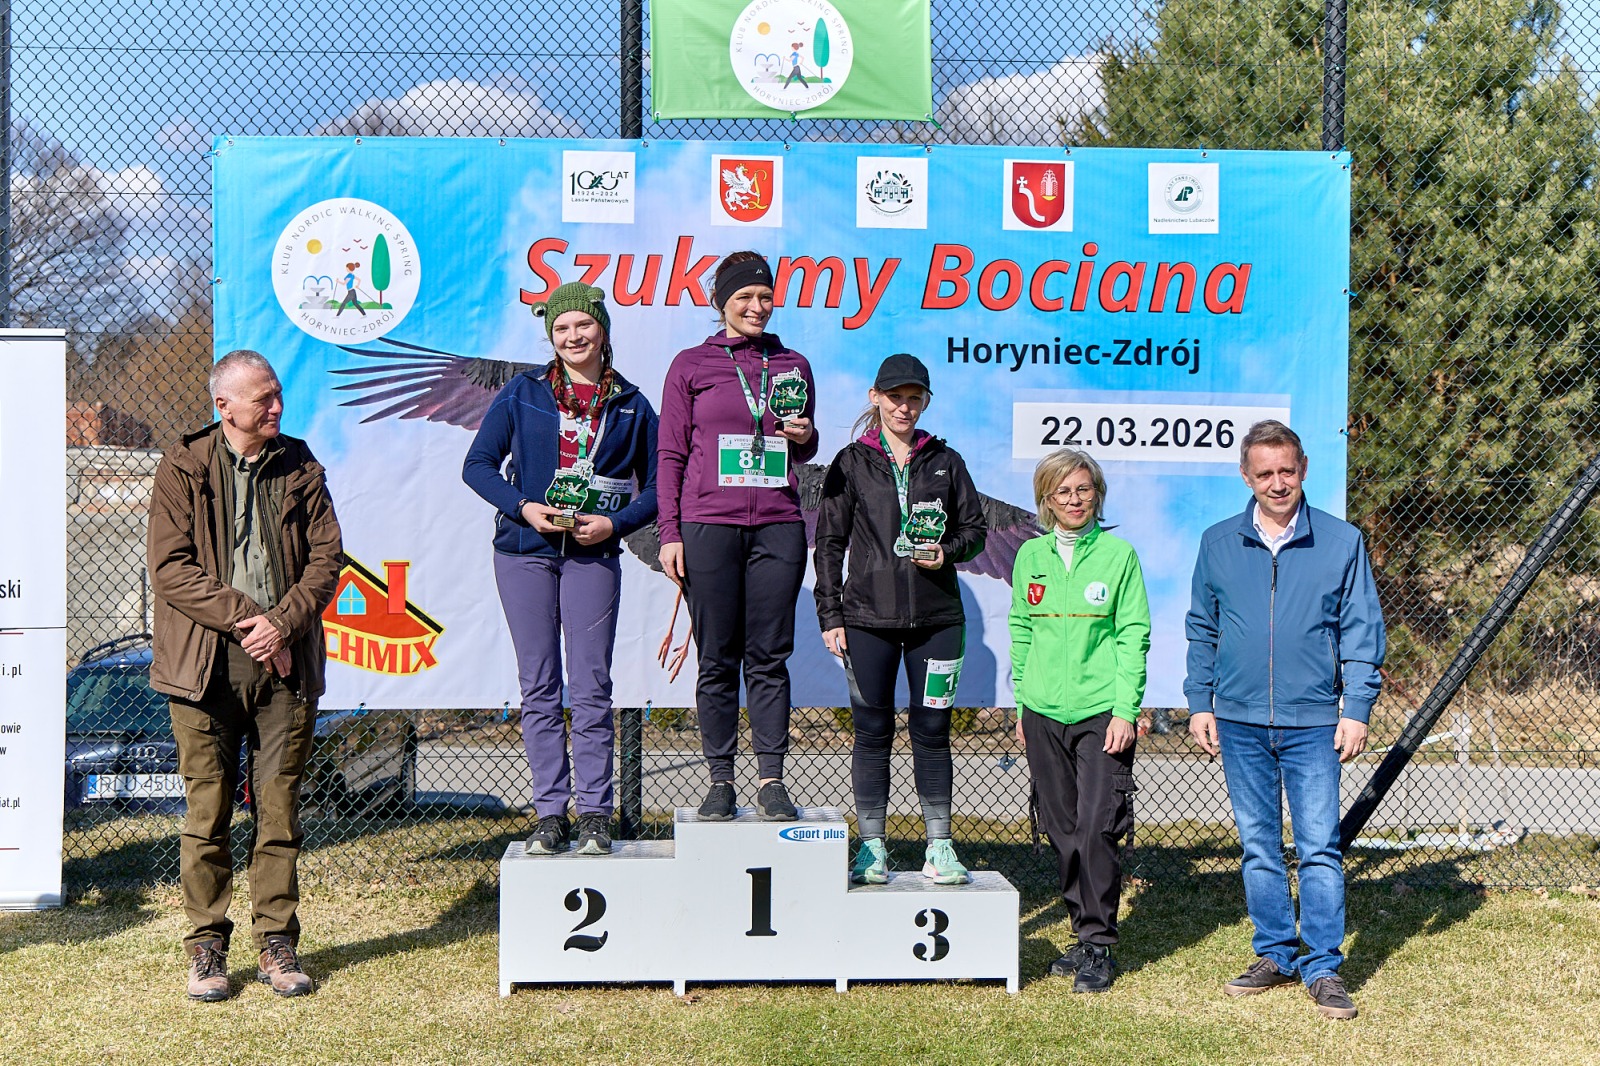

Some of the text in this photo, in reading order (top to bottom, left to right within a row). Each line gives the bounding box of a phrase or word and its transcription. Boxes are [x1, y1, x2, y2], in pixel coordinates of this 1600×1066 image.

[736, 27, 746, 53] KLUB
[832, 18, 848, 55] SPRING
[753, 84, 834, 106] HORYNIEC-ZDRÓJ
[610, 171, 629, 179] LAT
[281, 207, 412, 276] KLUB NORDIC WALKING SPRING
[519, 235, 1253, 330] Szukmy Bociana
[301, 310, 395, 336] HORYNIEC-ZDRÓJ
[946, 336, 1201, 375] Horyniec-Zdrój
[1040, 416, 1235, 449] 22.03.2026
[596, 492, 621, 511] 50
[0, 722, 21, 734] owie
[100, 776, 137, 792] RLU
[793, 829, 845, 840] sport plus
[745, 866, 778, 937] 1
[563, 887, 609, 952] 2
[912, 908, 950, 962] 3
